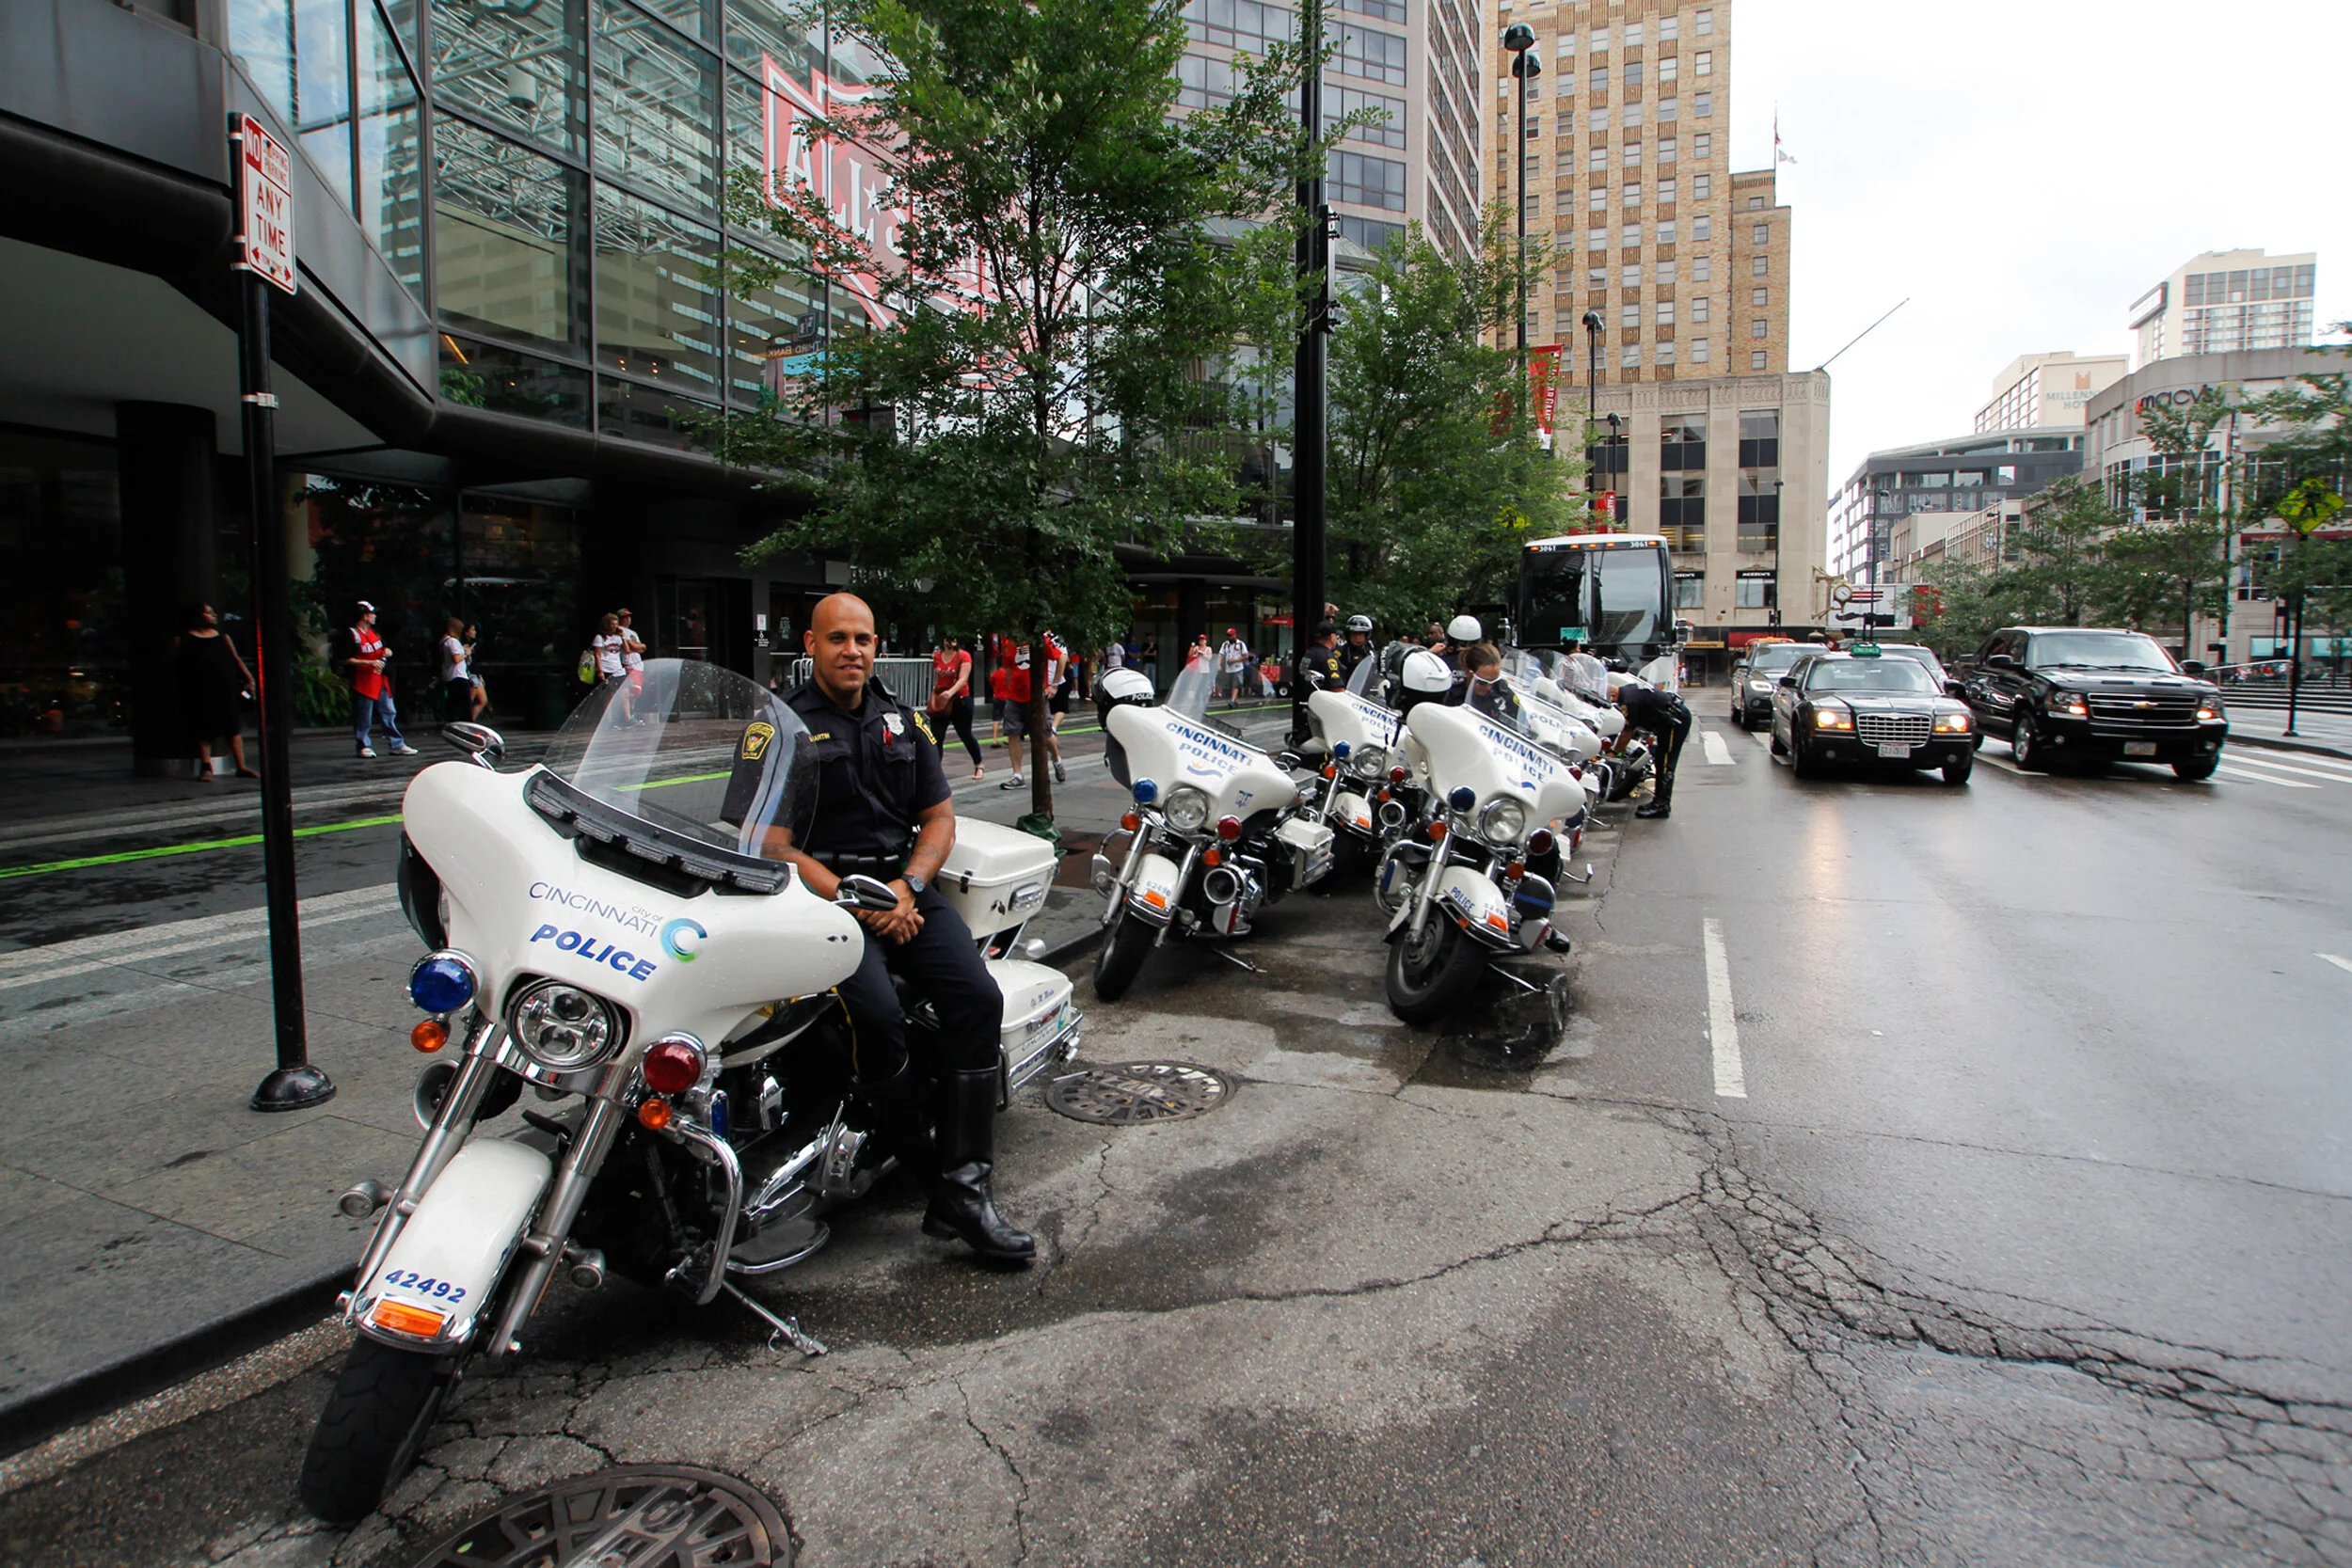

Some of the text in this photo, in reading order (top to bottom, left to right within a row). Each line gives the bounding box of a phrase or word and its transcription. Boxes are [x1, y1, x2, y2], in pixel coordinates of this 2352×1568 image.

[246, 124, 261, 162] NO
[257, 180, 283, 221] ANY
[255, 213, 286, 258] TIME
[2046, 389, 2098, 400] MILLENN
[1166, 721, 1253, 768] CINCINNATI
[1178, 742, 1240, 776] POLICE
[1478, 724, 1554, 775] CINCINNATI
[1492, 747, 1545, 784] POLICE
[529, 881, 659, 938] CINCINNATI
[631, 905, 664, 923] city of
[1450, 886, 1476, 911] POLICE
[529, 924, 658, 982] POLICE
[385, 1269, 467, 1304] 42492
